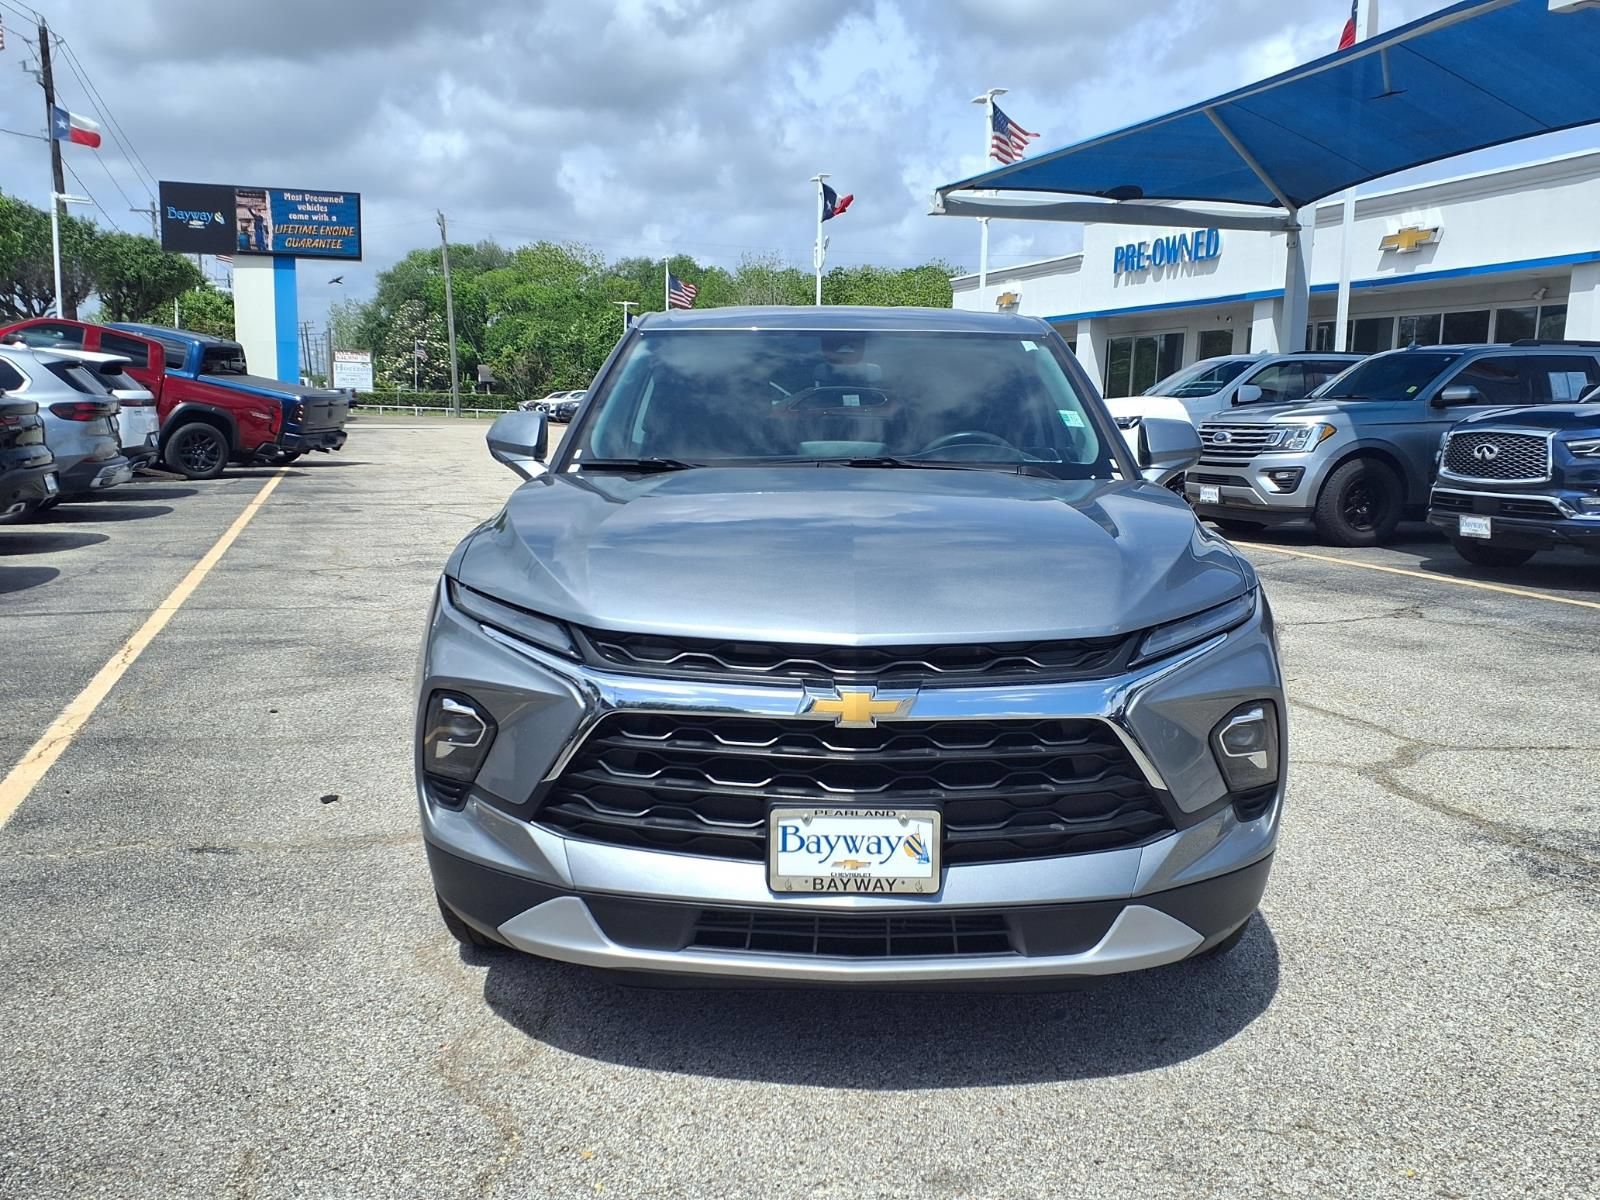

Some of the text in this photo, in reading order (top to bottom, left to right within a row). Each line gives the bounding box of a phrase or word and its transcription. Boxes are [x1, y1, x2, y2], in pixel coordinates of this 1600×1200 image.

[283, 192, 344, 204] Most Preowned
[297, 203, 328, 212] vehicles
[167, 206, 213, 225] Bayway
[311, 213, 329, 221] with
[275, 224, 355, 236] LIFETIME ENGINE
[285, 237, 343, 249] GUARANTEE
[1113, 227, 1220, 274] PRE-OWNED
[814, 809, 897, 817] PEARLAND
[778, 825, 904, 865] Bayway
[812, 878, 897, 892] BAYWAY
